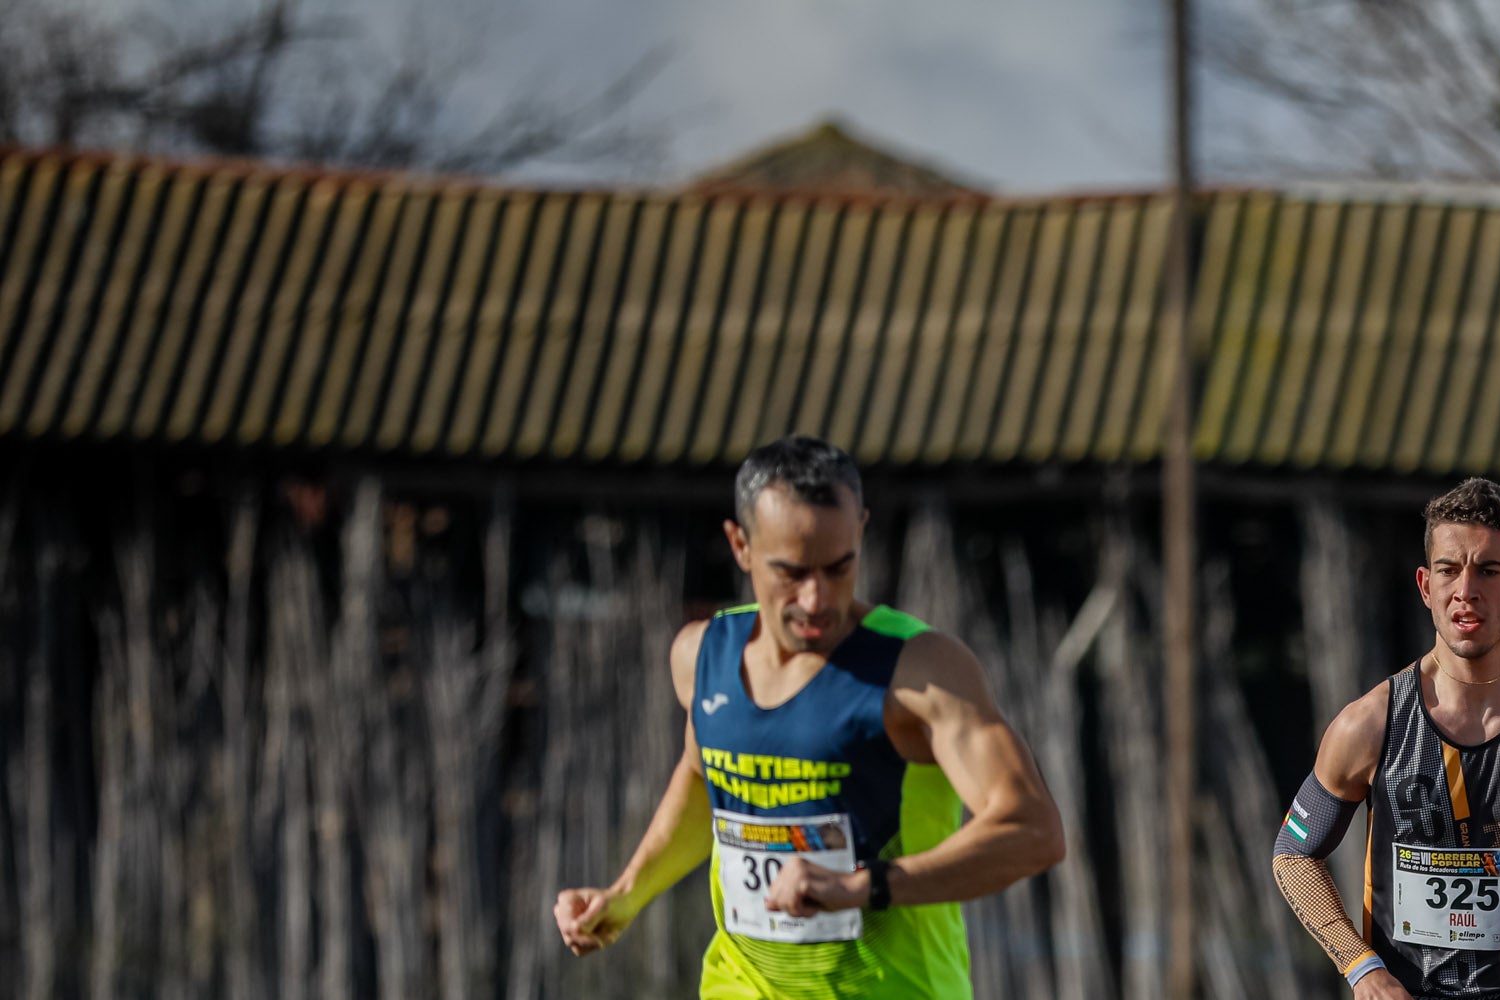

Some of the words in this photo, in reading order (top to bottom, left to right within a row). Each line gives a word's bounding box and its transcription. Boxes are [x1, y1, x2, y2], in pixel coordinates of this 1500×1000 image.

[702, 747, 850, 779] ATLETISMO
[1400, 849, 1412, 859] 26
[1431, 852, 1481, 861] CARRERA
[1425, 877, 1500, 912] 325
[1449, 911, 1478, 928] RAÚL
[1459, 930, 1485, 939] olimpo
